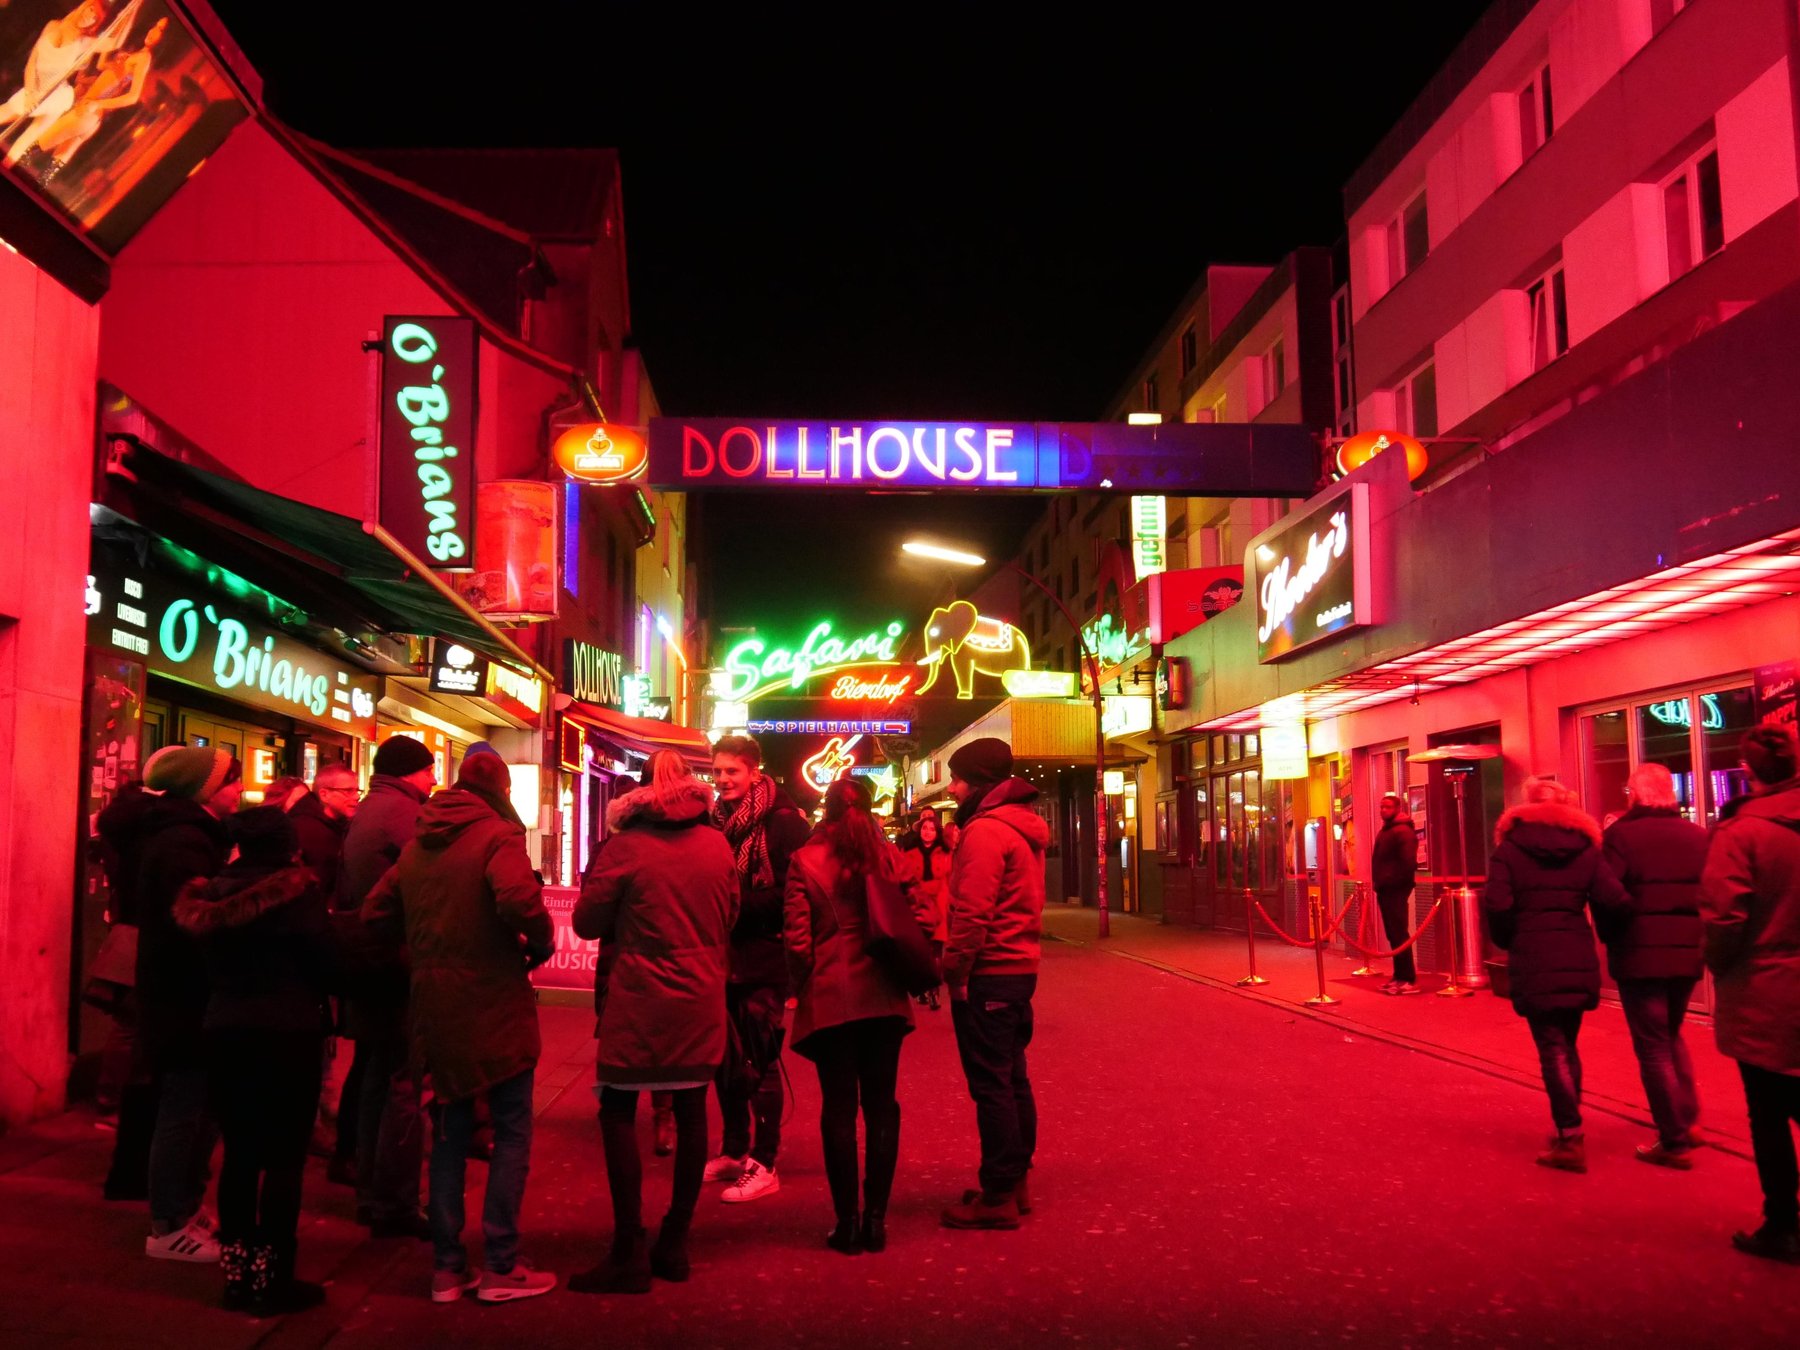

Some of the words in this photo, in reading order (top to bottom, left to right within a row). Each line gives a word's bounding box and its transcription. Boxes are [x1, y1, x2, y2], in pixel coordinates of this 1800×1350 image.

[682, 425, 1017, 481] DOLLHOUSE
[573, 639, 622, 705] DOLLHOUSE
[721, 622, 902, 698] Safari
[831, 674, 911, 704] Bierdorf
[776, 720, 881, 733] SPIELHALLE
[543, 896, 577, 908] Eintri
[557, 925, 600, 951] IV
